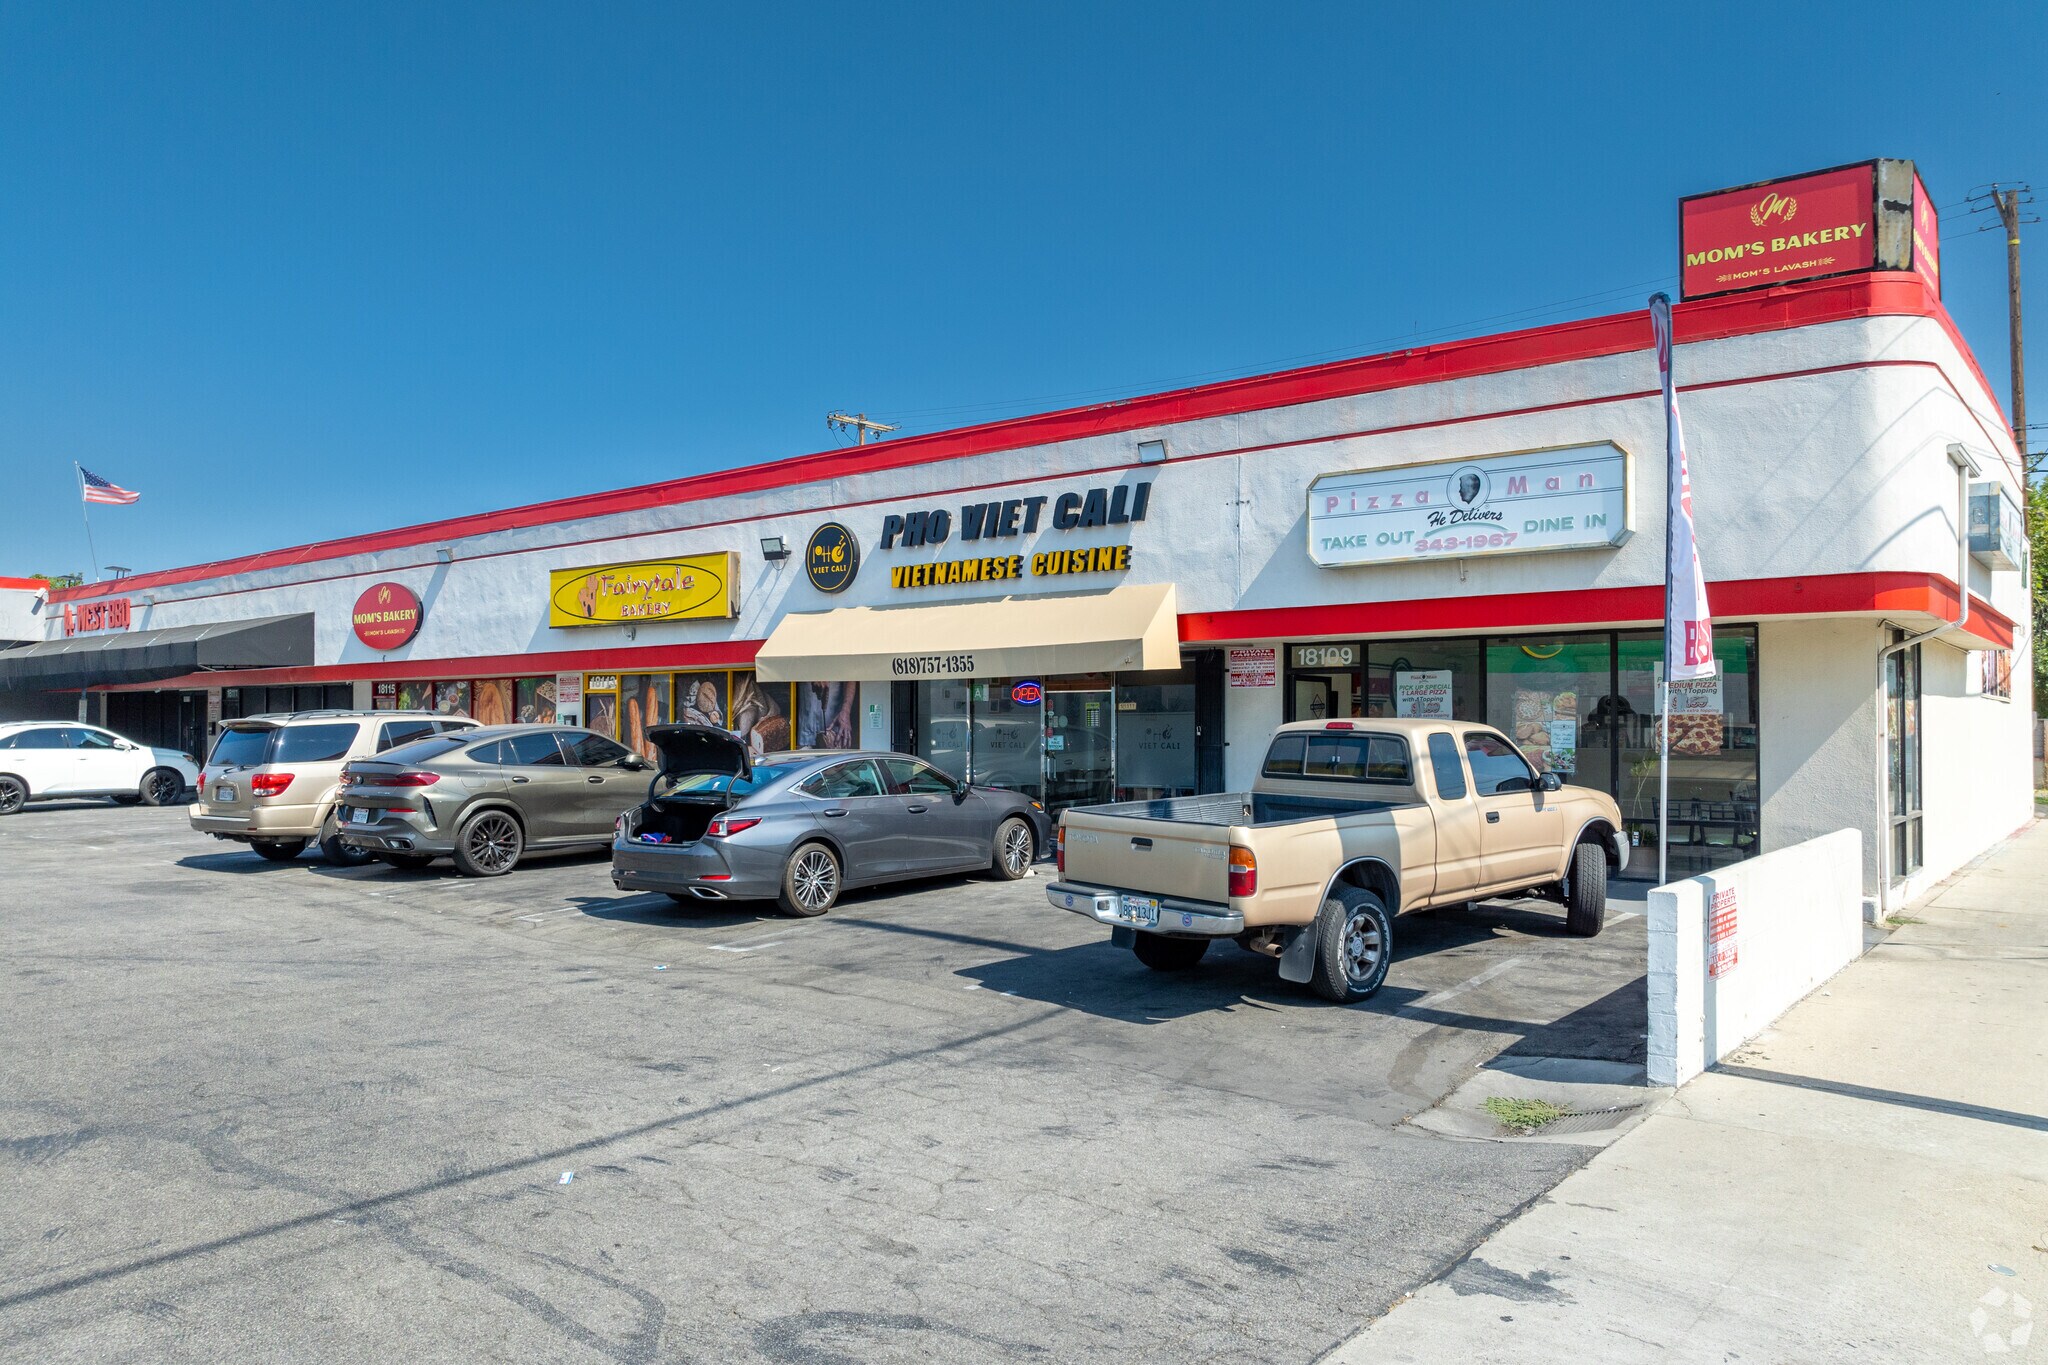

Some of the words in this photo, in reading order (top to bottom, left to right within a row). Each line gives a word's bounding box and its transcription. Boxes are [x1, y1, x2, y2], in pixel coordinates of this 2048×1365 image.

[1686, 241, 1766, 267] MOM'S
[1771, 222, 1867, 252] BAKERY
[1732, 267, 1770, 280] MOM'S
[1774, 260, 1817, 273] LAVASH
[1326, 488, 1430, 513] Pizza
[1507, 471, 1595, 496] Man
[880, 508, 952, 549] PHO
[961, 496, 1048, 541] VIET
[1053, 482, 1152, 530] CALI
[1427, 511, 1447, 528] He
[1450, 507, 1503, 524] Delivers
[1524, 516, 1574, 534] DINE
[1585, 513, 1607, 528] IN
[1321, 534, 1368, 552] TAKE
[1376, 530, 1415, 546] OUT
[1414, 532, 1518, 552] 343-1967
[813, 566, 829, 574] VIET
[831, 564, 847, 573] CALI
[891, 554, 1024, 588] VIETNAMESE
[1032, 545, 1132, 576] CUISINE
[600, 566, 695, 601] Fairytale
[108, 598, 130, 630] BBQ
[354, 612, 382, 624] MOM'S
[384, 608, 416, 622] BAKERY
[621, 602, 670, 617] BAKERY
[892, 655, 974, 676] (818)757-1355
[1298, 648, 1352, 666] 18109
[378, 683, 396, 694] 18115
[974, 686, 981, 698] A
[1012, 687, 1042, 700] OPEN
[1711, 896, 1736, 912] PROPERTY
[1712, 887, 1735, 903] PRIVATE
